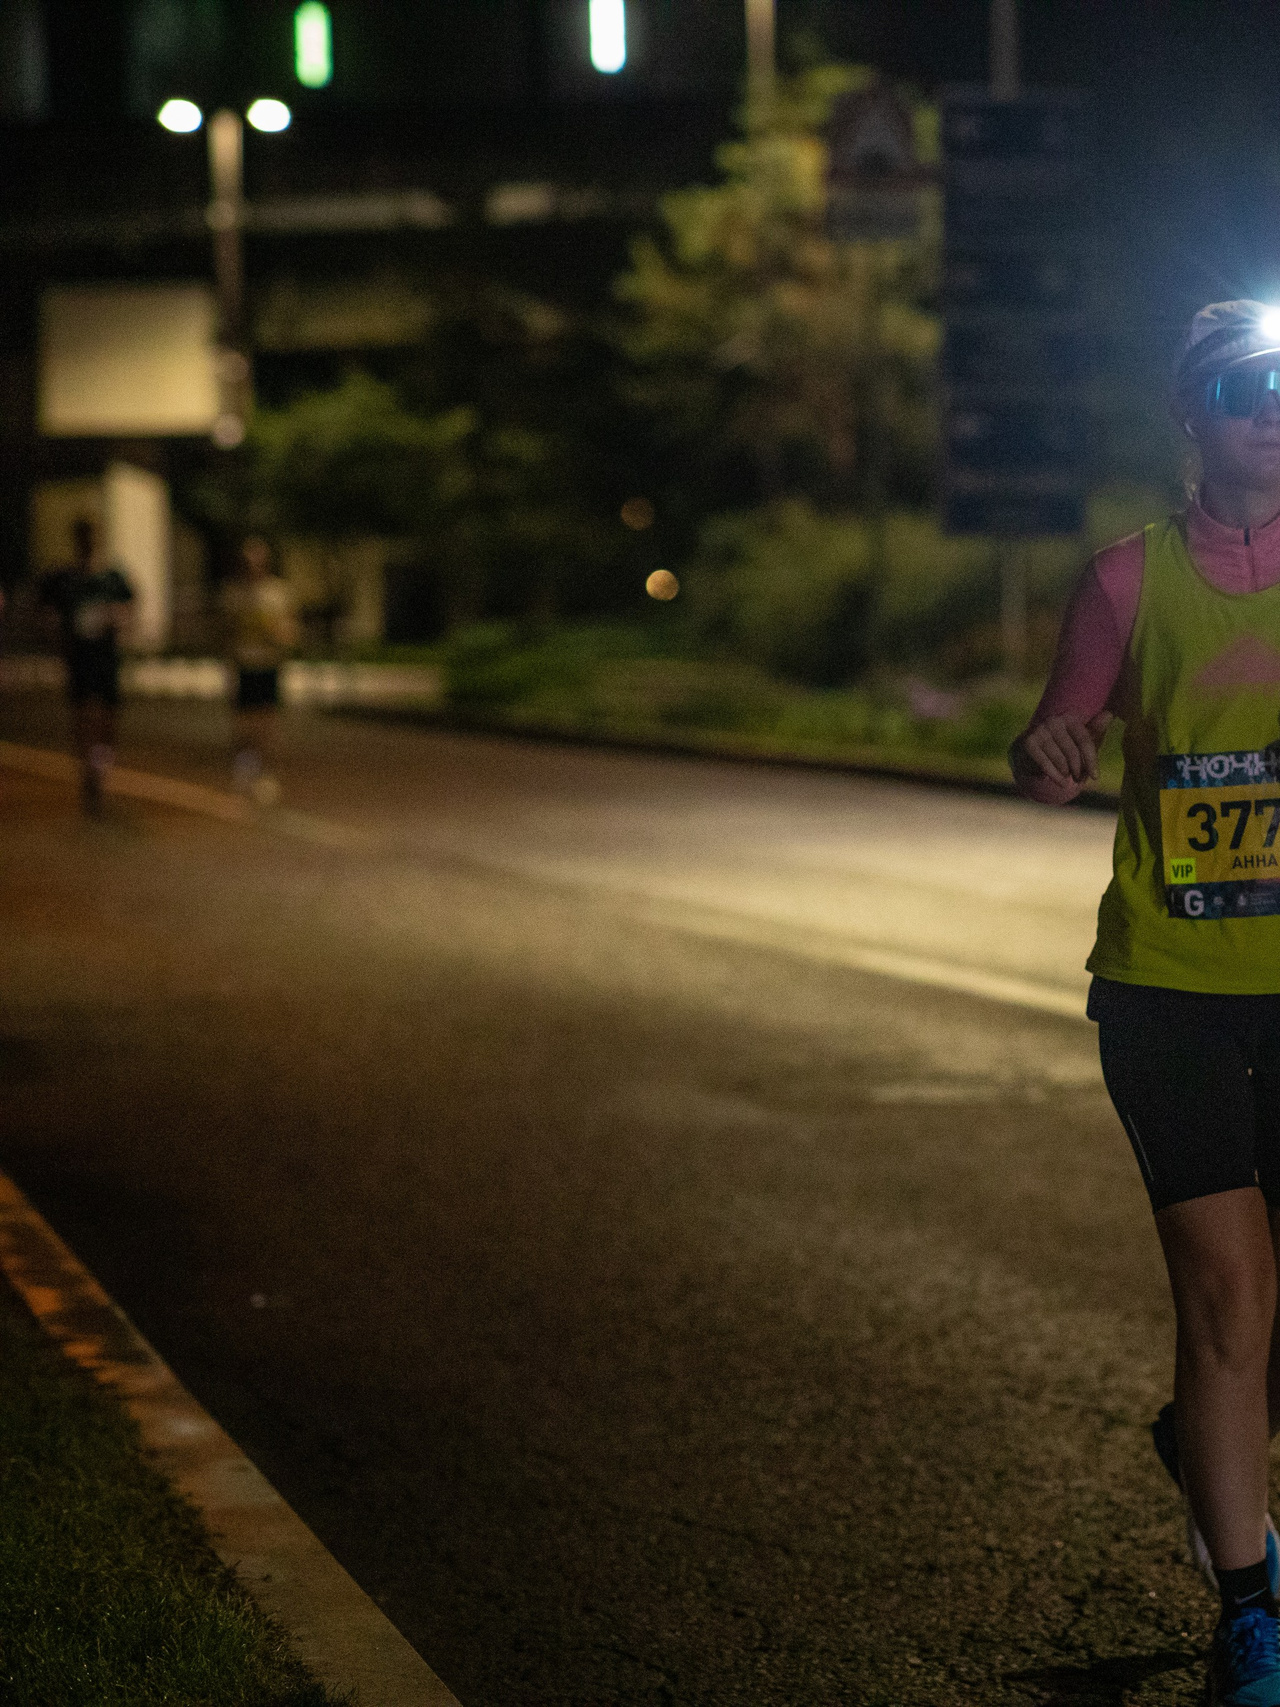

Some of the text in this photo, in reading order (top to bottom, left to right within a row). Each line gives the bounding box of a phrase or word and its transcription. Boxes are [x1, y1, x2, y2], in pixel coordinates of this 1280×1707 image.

[1232, 853, 1279, 870] АННА
[1171, 863, 1194, 879] VIP
[1184, 889, 1205, 916] G
